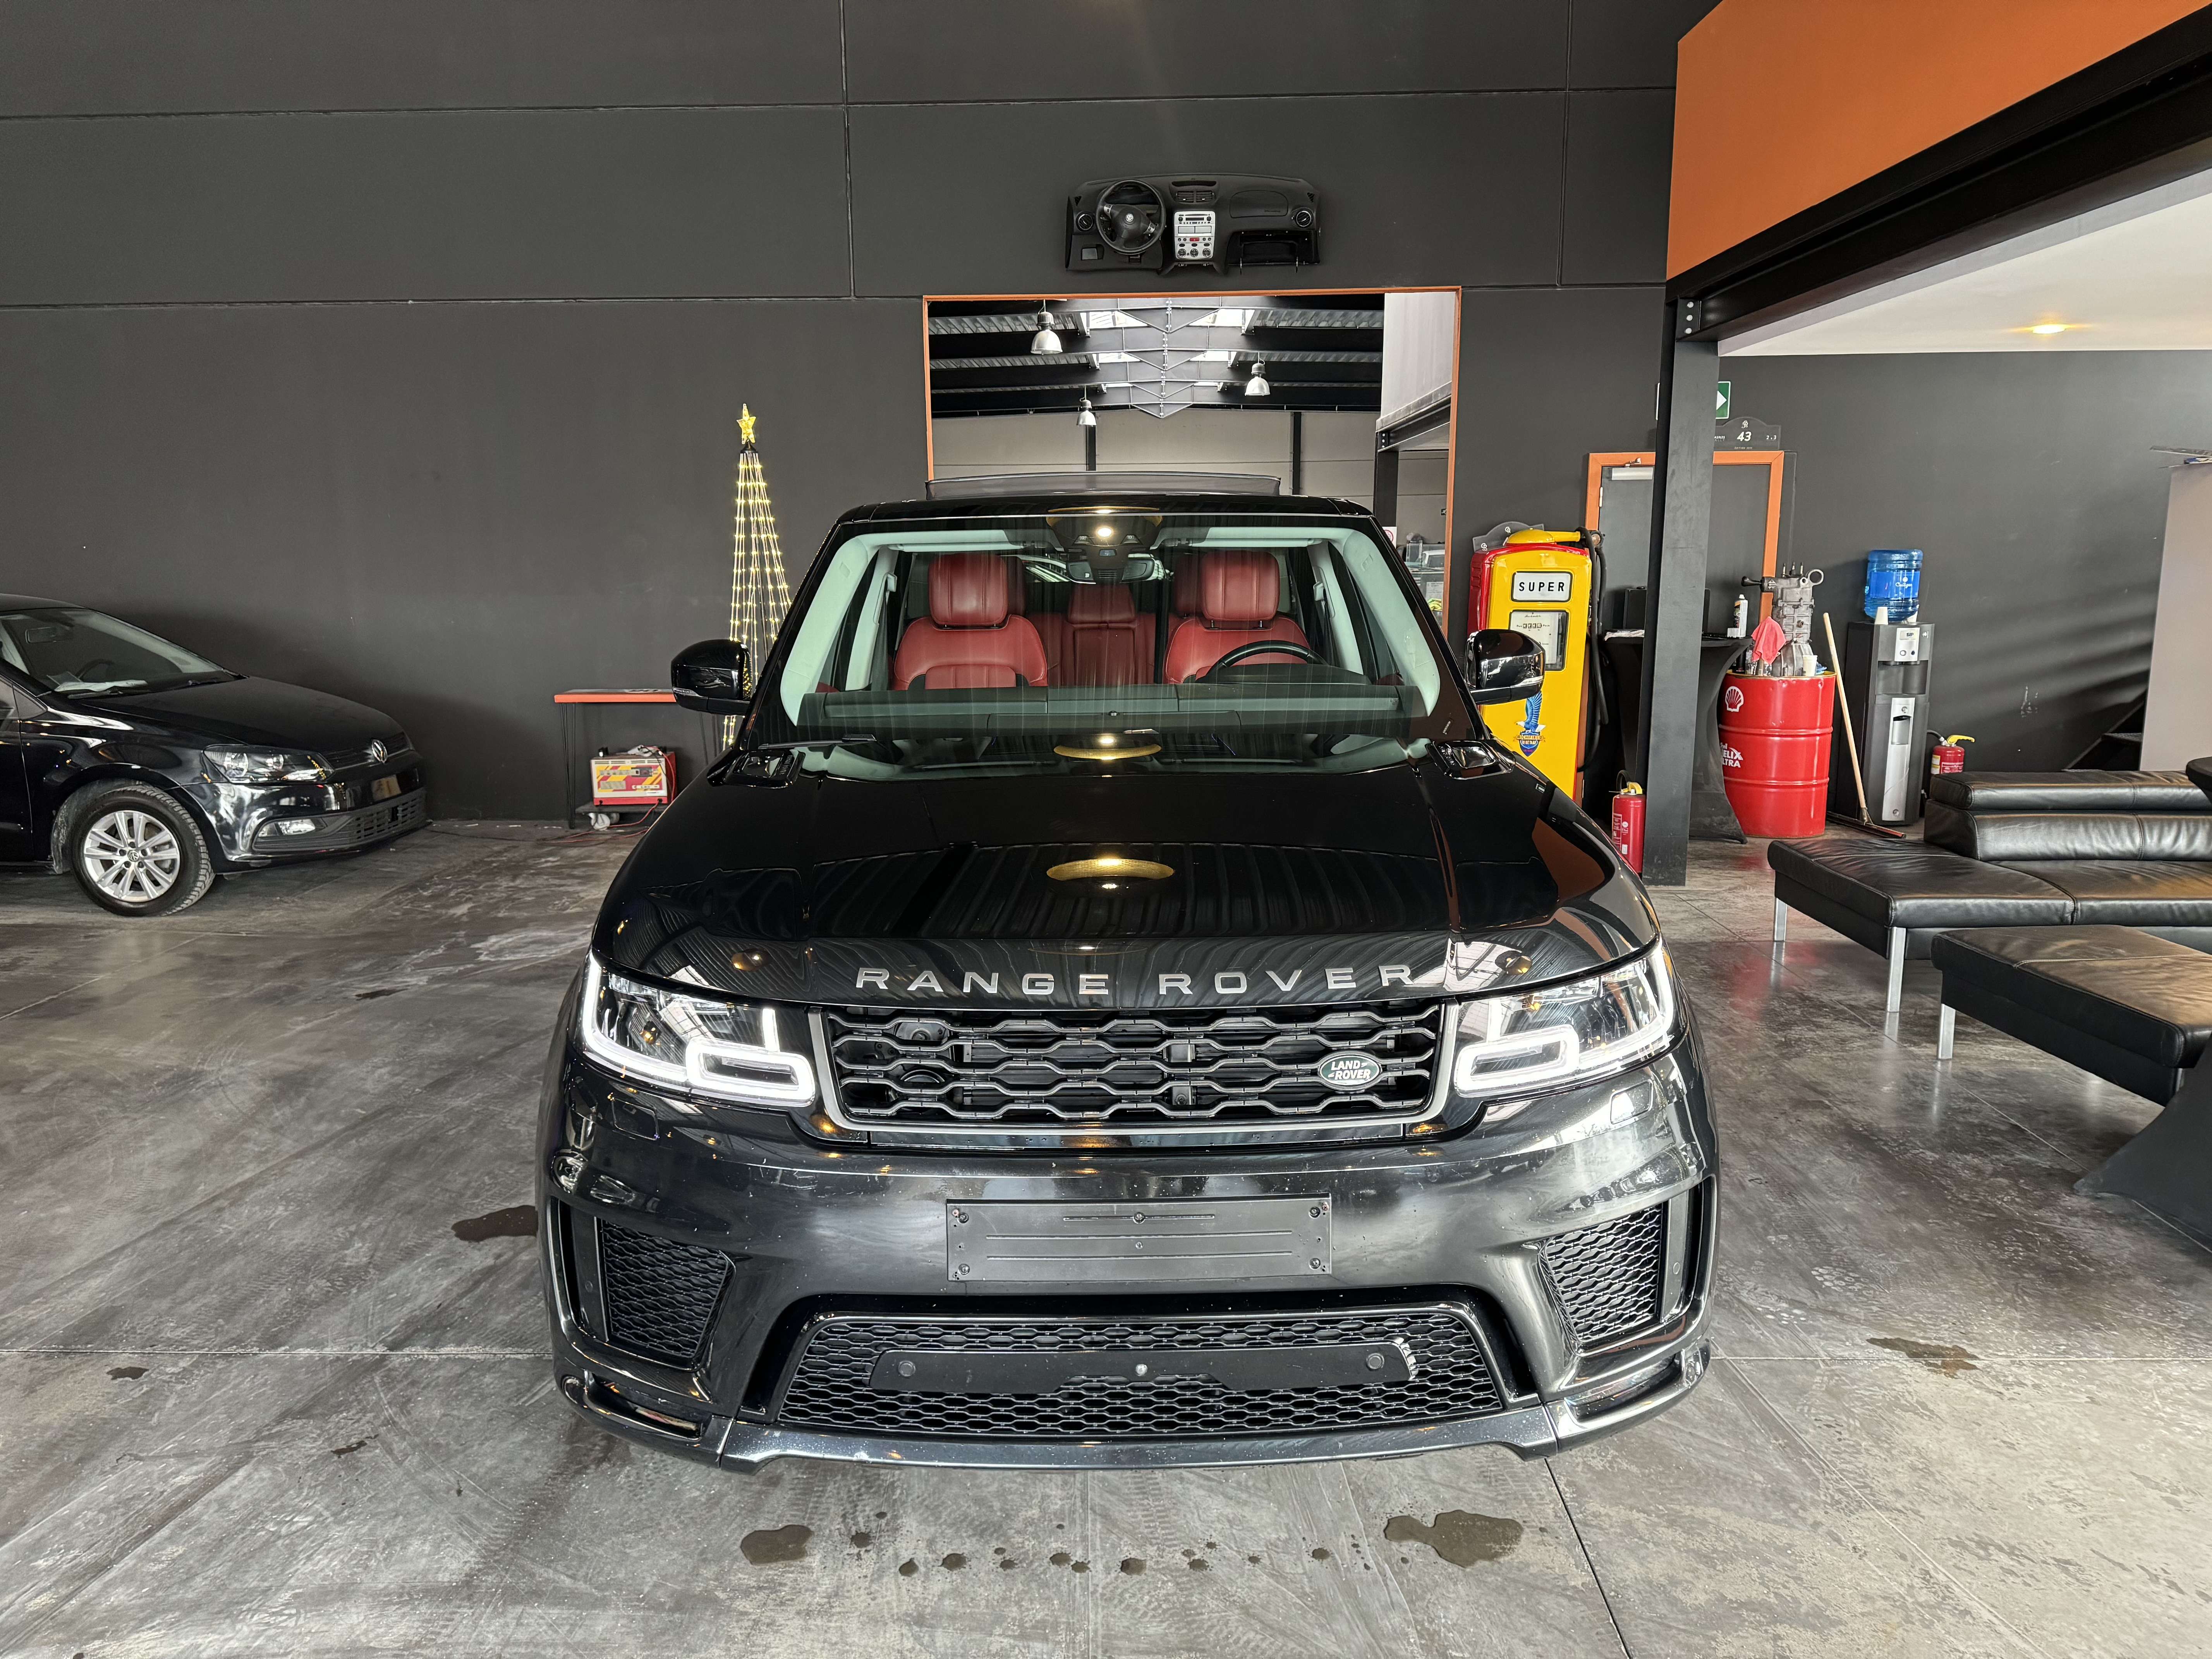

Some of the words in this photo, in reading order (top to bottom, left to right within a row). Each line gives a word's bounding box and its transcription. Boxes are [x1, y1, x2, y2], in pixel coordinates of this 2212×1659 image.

[1736, 431, 1752, 442] 43
[1518, 582, 1565, 592] SUPER
[1723, 747, 1743, 761] ELIX
[1722, 758, 1741, 768] LTRA
[855, 967, 1109, 995] RANGE
[1159, 964, 1414, 995] ROVER
[1331, 1060, 1360, 1071] LAND
[1334, 1069, 1371, 1080] ROVER
